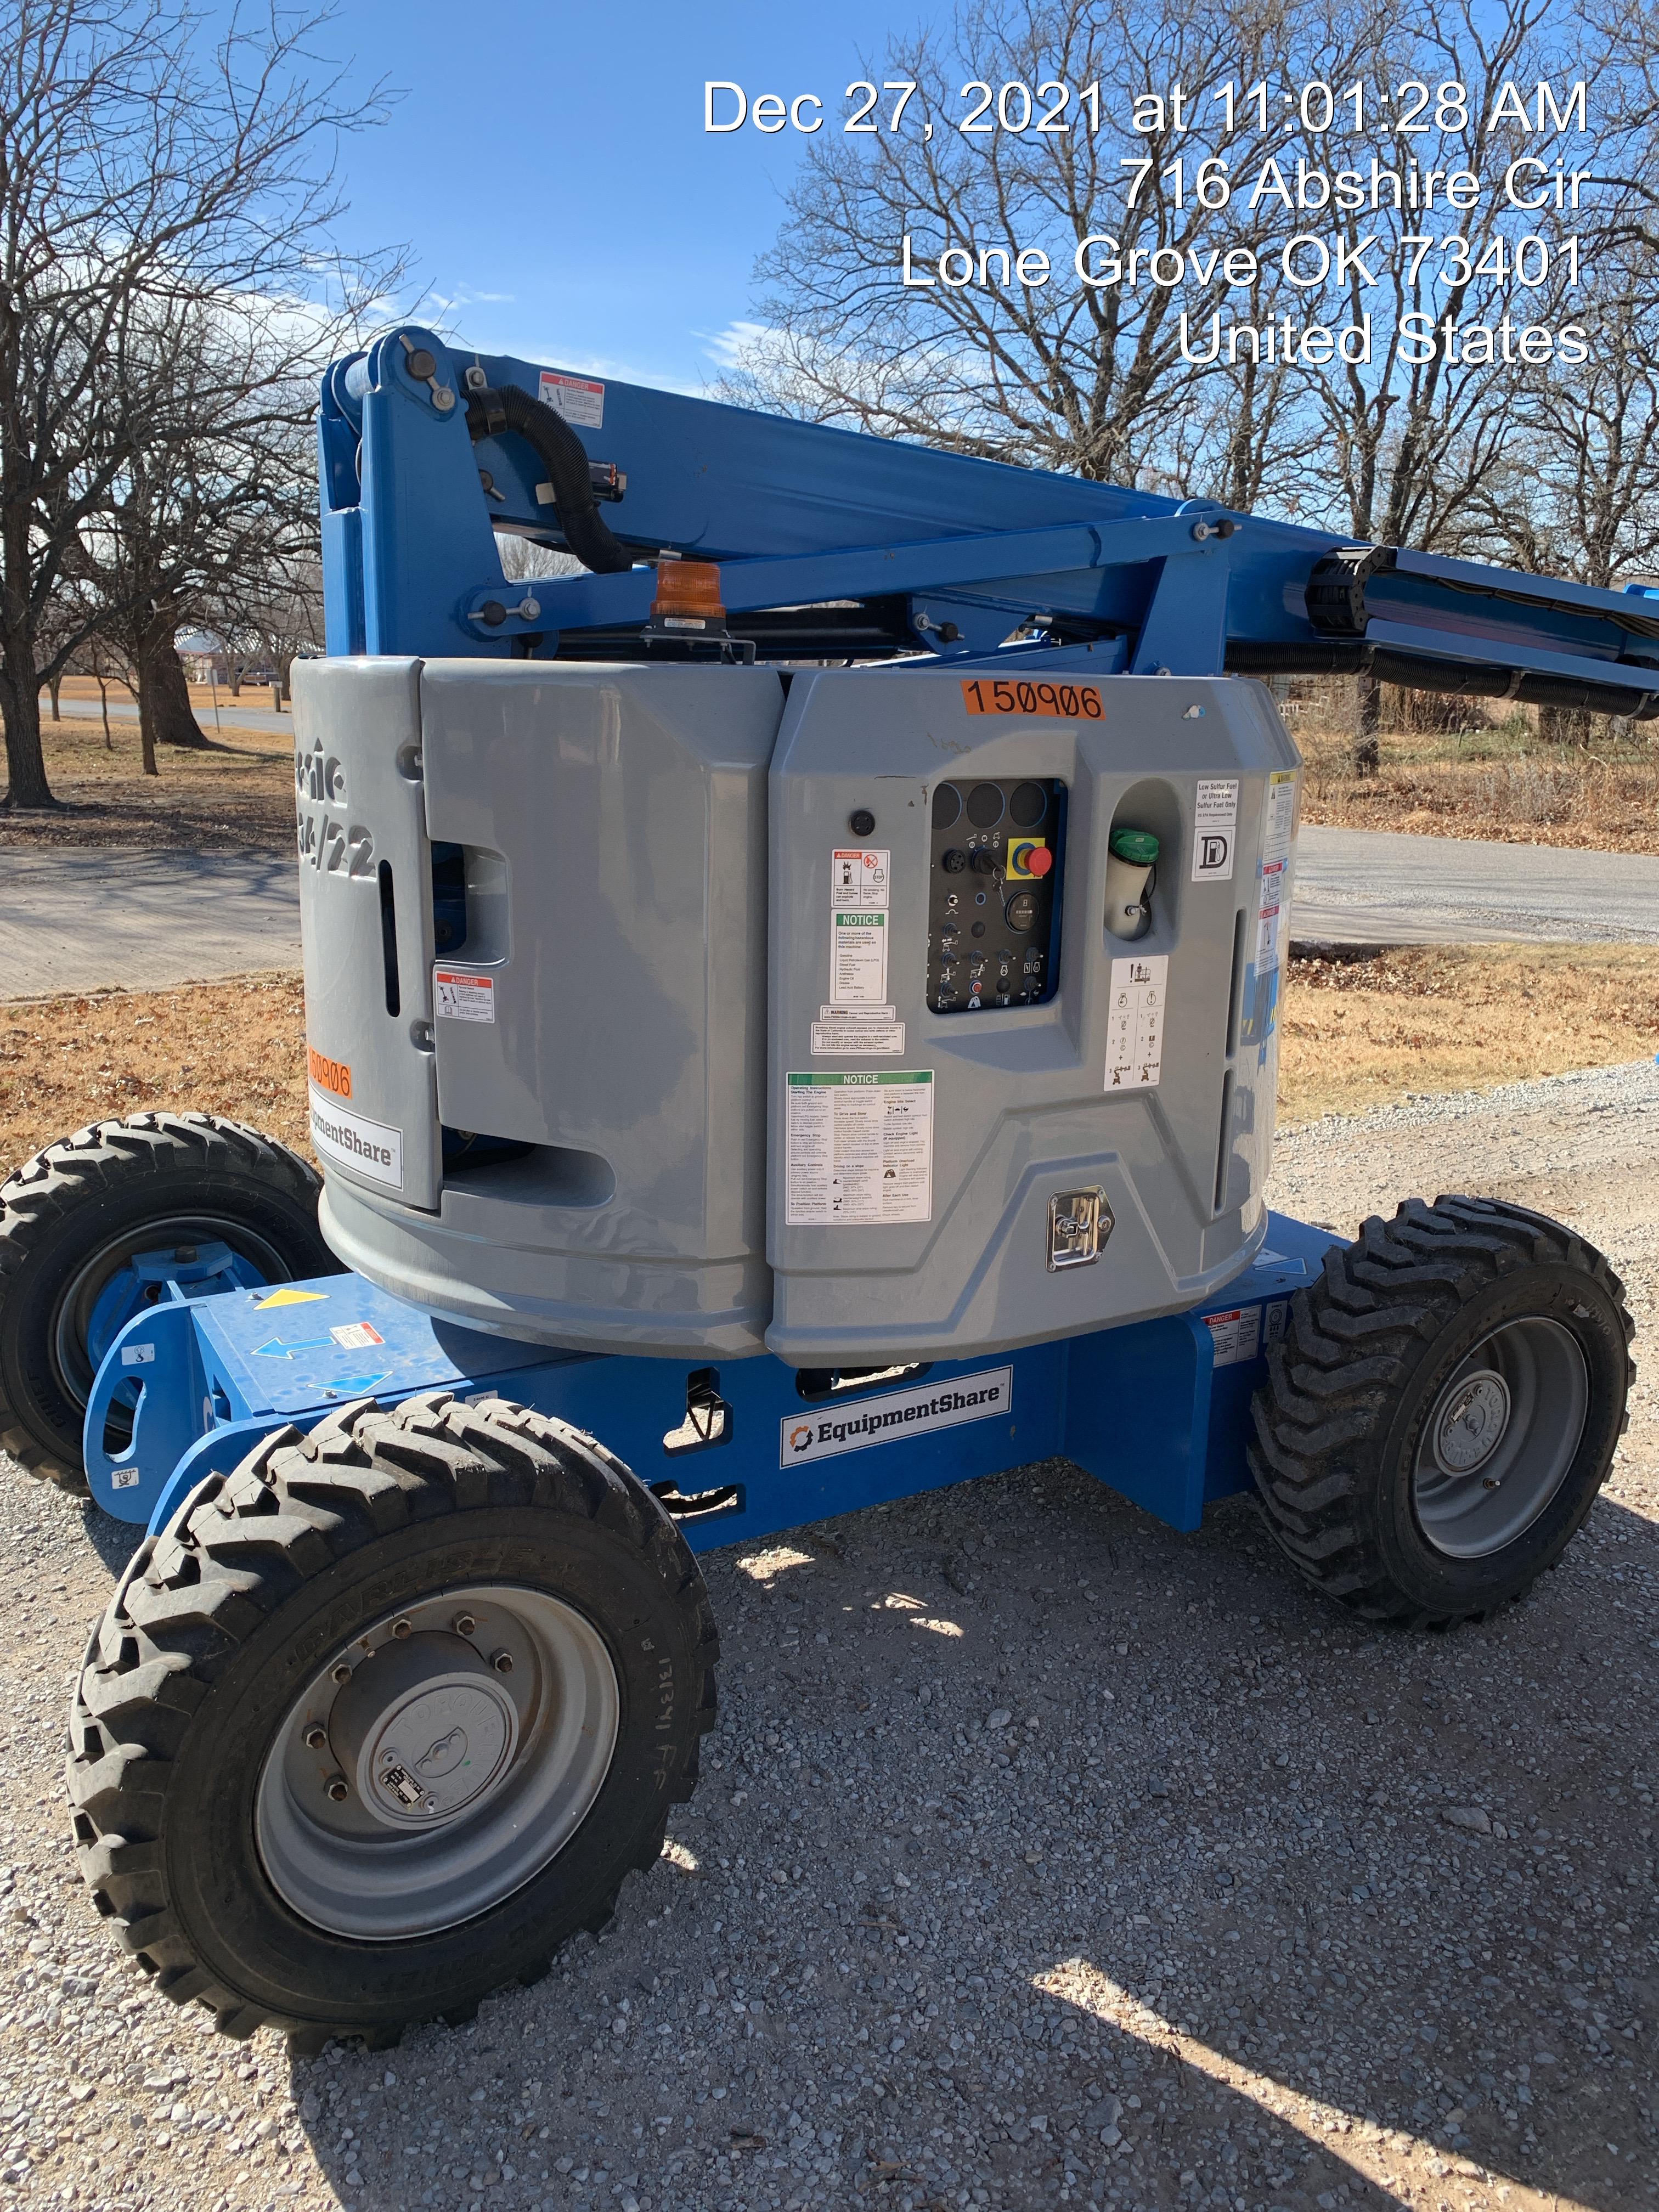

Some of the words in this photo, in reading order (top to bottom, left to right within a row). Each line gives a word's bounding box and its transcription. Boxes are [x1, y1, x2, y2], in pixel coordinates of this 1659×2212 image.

[565, 380, 589, 390] DANGER
[963, 681, 1102, 718] 150906
[843, 915, 878, 925] NOTICE
[456, 977, 478, 985] DANGER
[844, 1075, 878, 1084] NOTICE
